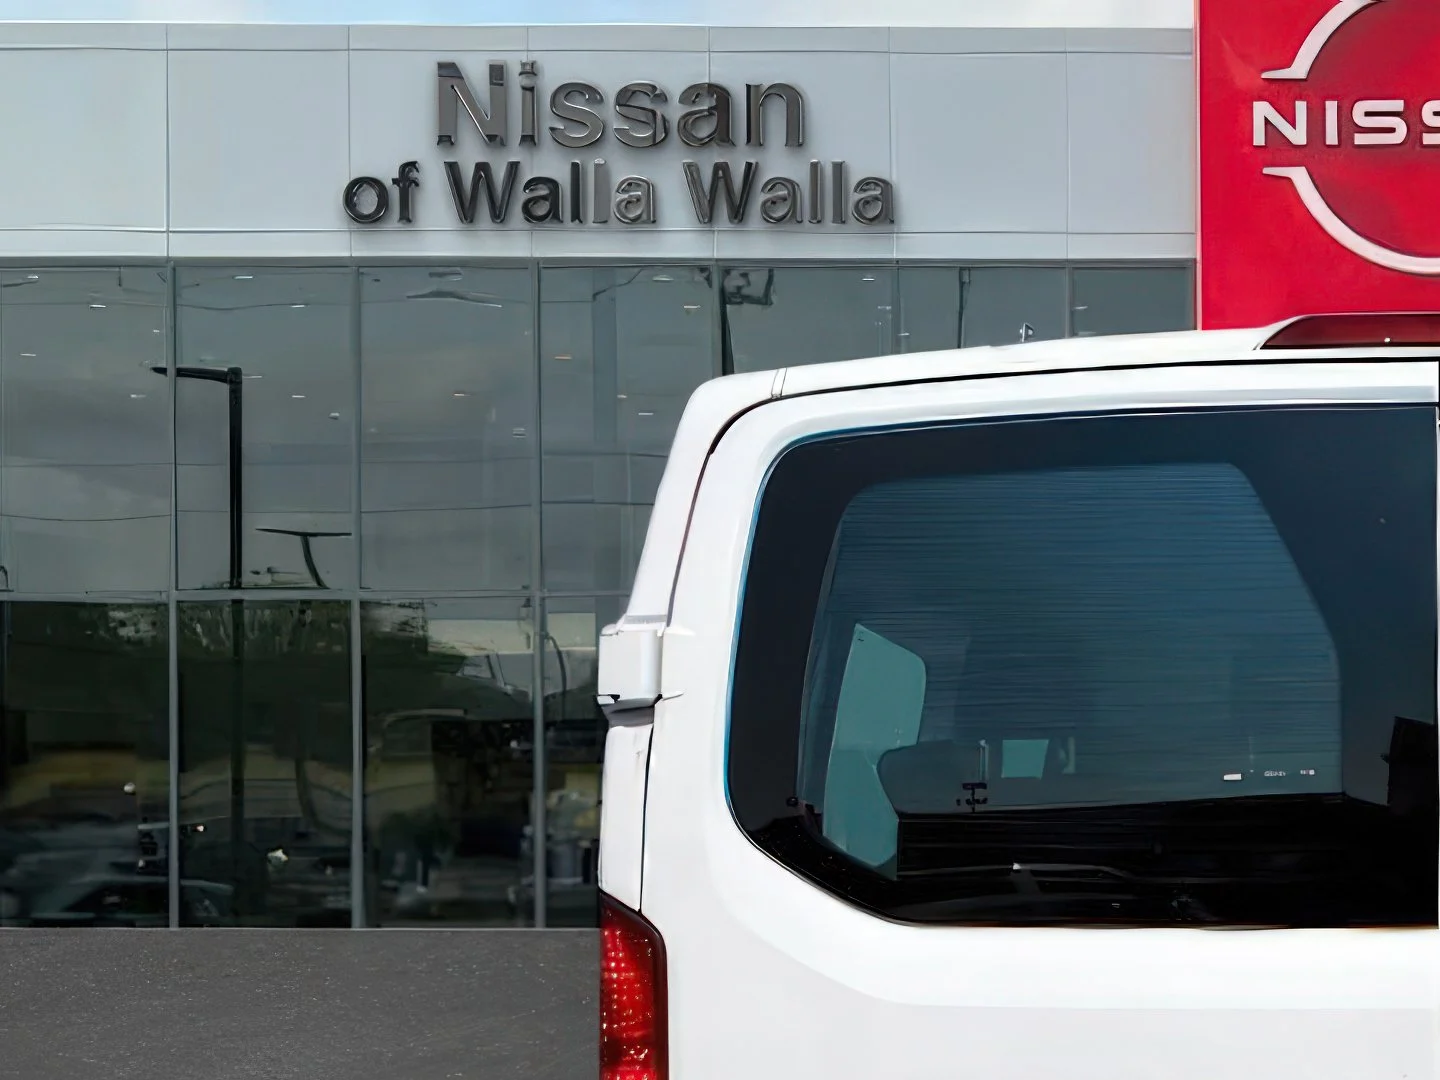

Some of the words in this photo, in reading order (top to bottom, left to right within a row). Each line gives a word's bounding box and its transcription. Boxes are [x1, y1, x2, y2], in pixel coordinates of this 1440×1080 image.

[437, 61, 808, 148] Nissan
[342, 160, 419, 224] of
[444, 160, 657, 225] Walla
[682, 160, 895, 225] Walla
